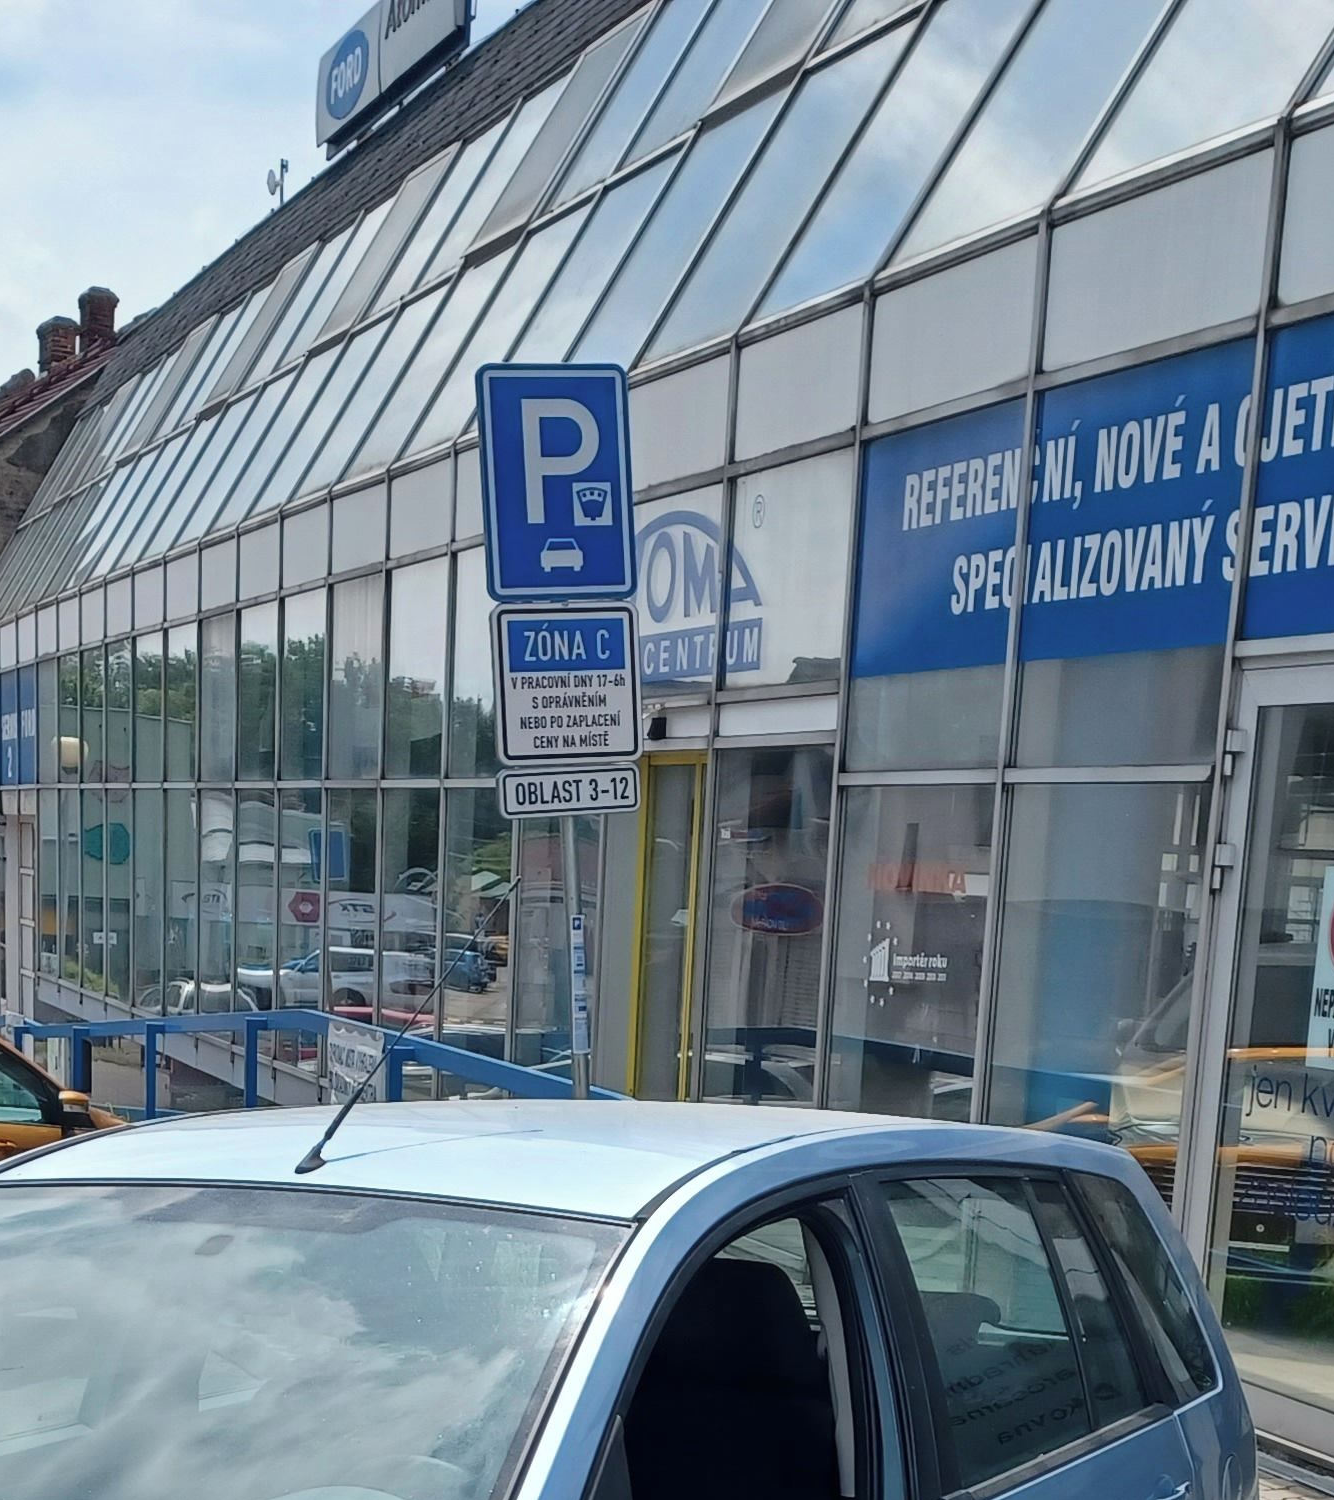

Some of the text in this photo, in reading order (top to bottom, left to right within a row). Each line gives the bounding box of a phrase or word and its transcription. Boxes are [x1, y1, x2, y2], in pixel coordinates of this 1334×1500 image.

[385, 0, 430, 40] Ato
[330, 46, 362, 105] FORD
[520, 398, 600, 524] P
[1093, 394, 1186, 493] NOVÉ
[1195, 402, 1220, 474] A
[523, 622, 611, 662] ZÓNA C
[510, 672, 626, 690] V PRACOVNÍ DNY 17-6h
[531, 690, 607, 710] S OPRÁVNĚNÍM
[520, 710, 621, 730] NEBO PO ZAPLACENÍ
[533, 730, 610, 749] CENY NA MÍSTĚ
[515, 776, 630, 806] OBLAST 3-12
[1245, 1064, 1293, 1117] jen
